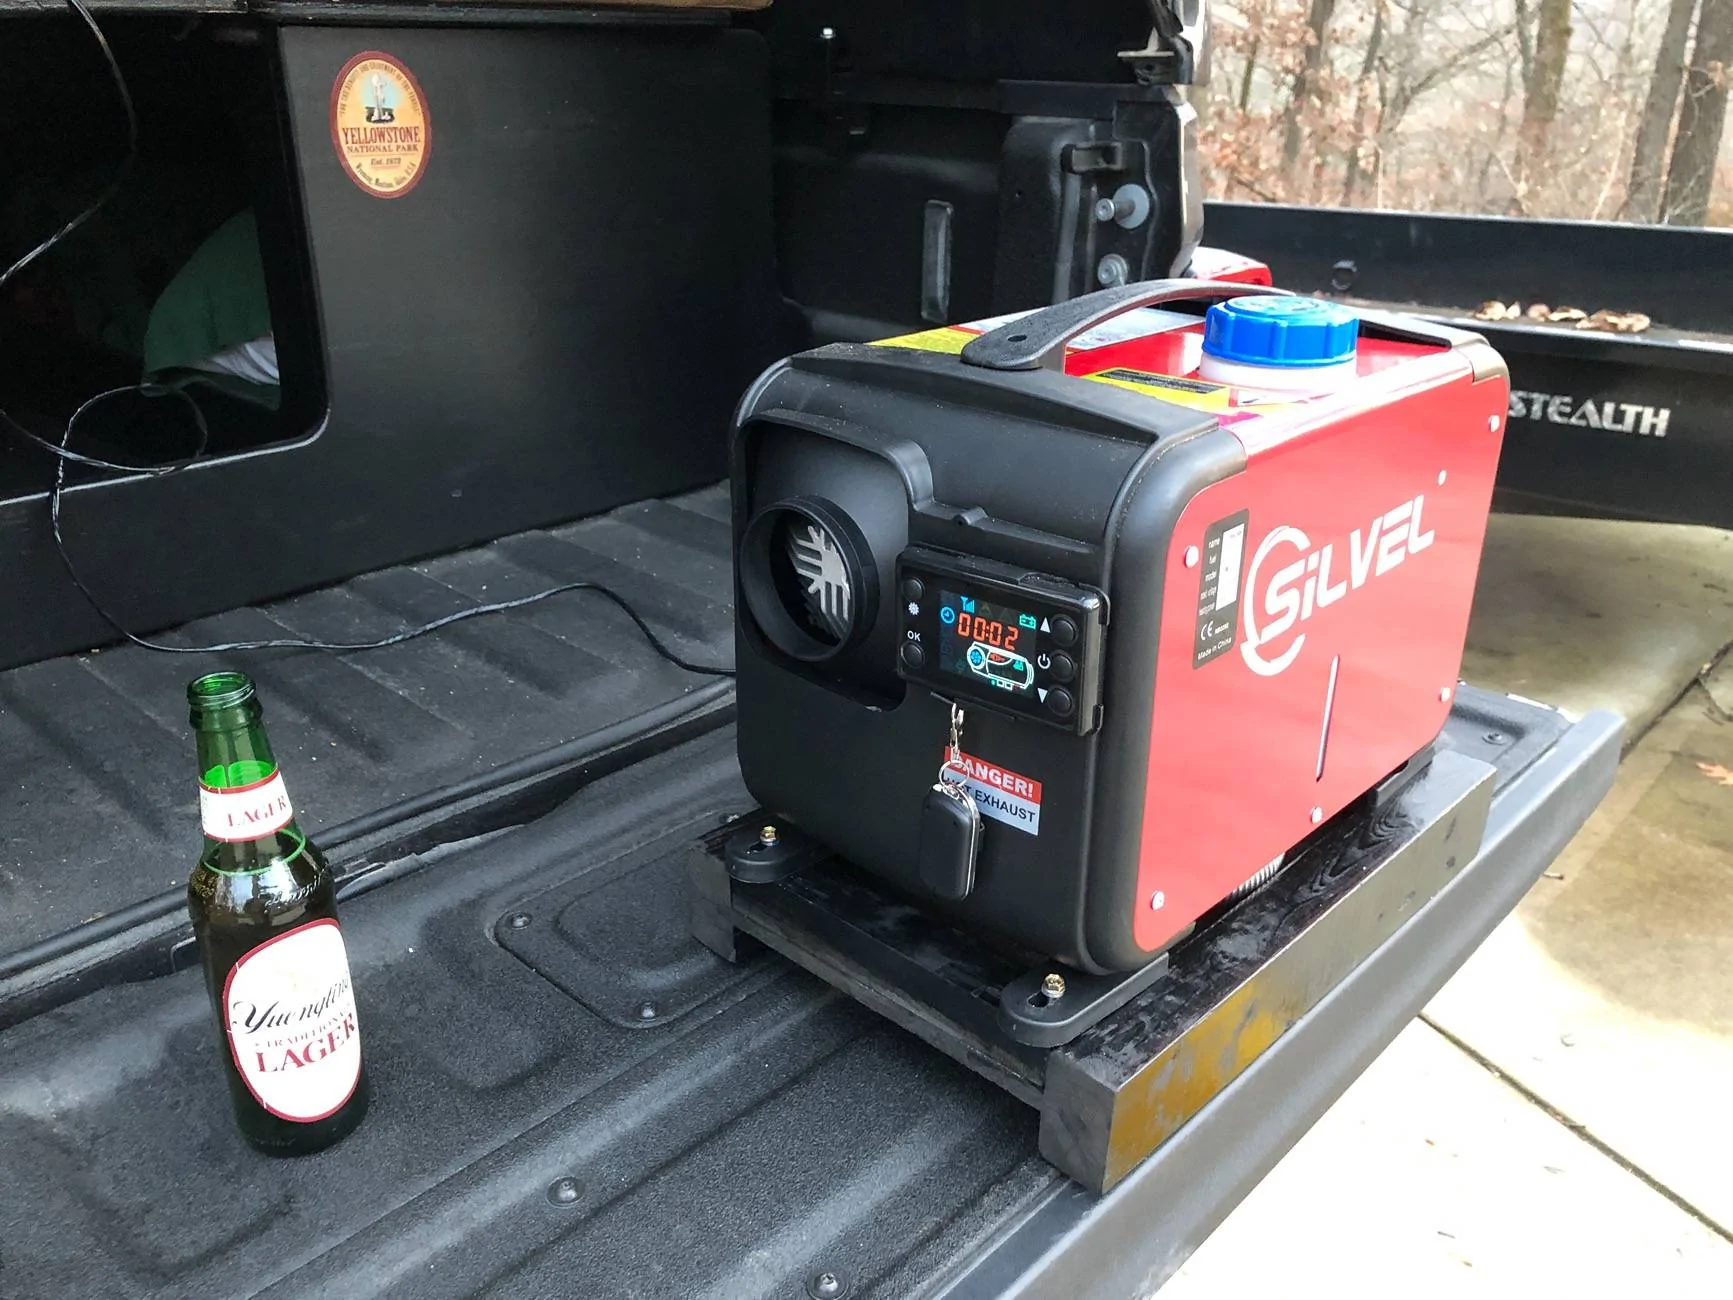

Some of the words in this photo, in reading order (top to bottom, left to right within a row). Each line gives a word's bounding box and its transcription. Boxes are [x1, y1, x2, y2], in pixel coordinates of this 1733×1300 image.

[342, 126, 420, 145] YELLOWSTONE
[347, 145, 393, 153] NATIONAL
[396, 144, 418, 152] PARK
[1508, 390, 1671, 437] STEALTH
[907, 630, 921, 642] OK
[958, 612, 1019, 651] 00:02
[974, 789, 1035, 822] EXHAUST
[256, 1012, 355, 1072] LAGER
